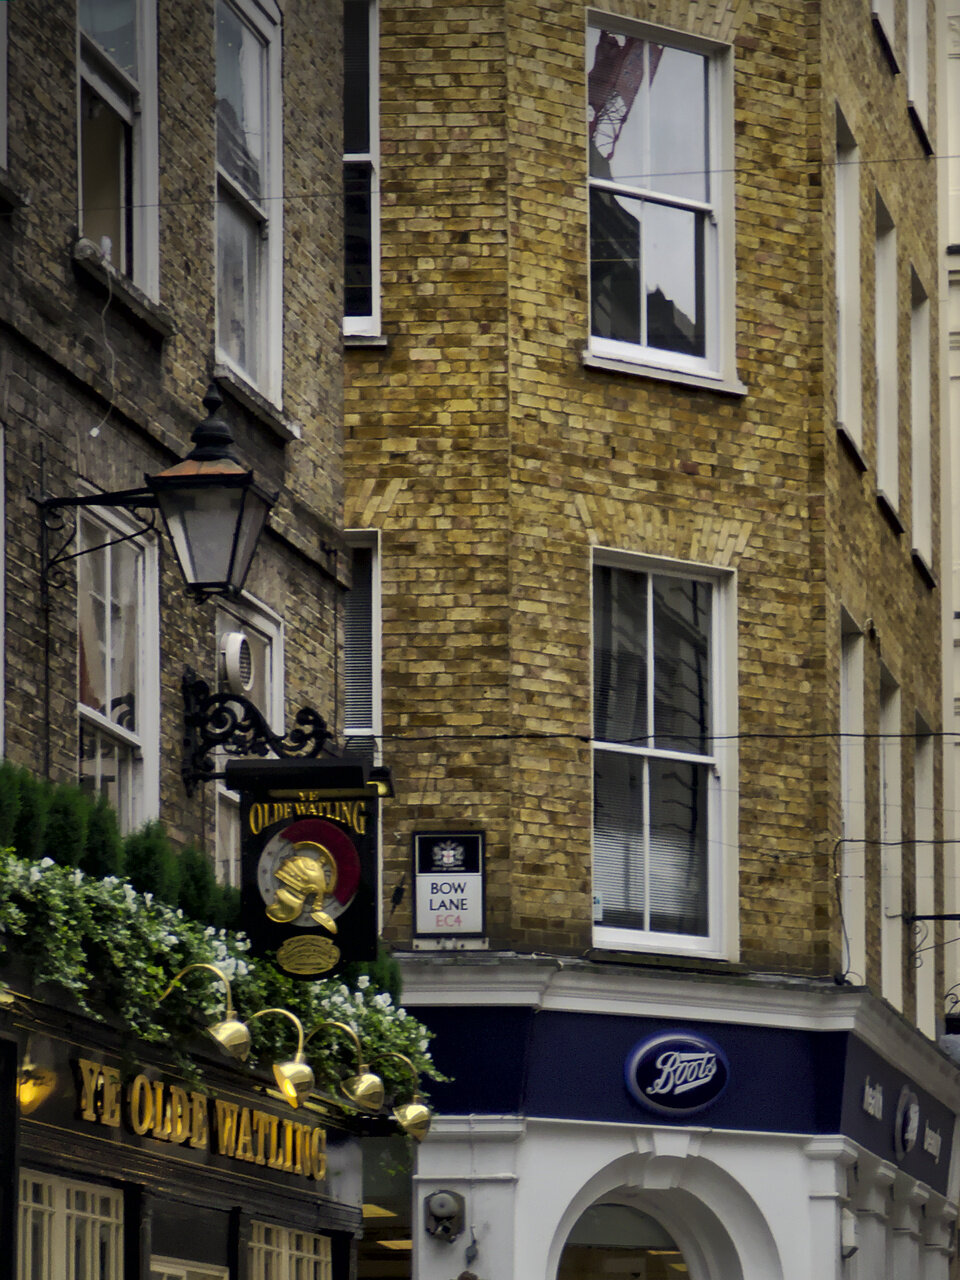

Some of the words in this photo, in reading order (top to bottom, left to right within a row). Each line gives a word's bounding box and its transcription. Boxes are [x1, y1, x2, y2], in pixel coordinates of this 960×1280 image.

[298, 791, 319, 800] YE
[250, 802, 292, 835] OLDE
[295, 801, 368, 835] WATLING
[431, 882, 467, 894] BOW
[429, 898, 468, 911] LANE
[435, 914, 462, 927] EC4
[646, 1051, 718, 1095] Boots
[78, 1058, 121, 1128] YE
[131, 1073, 208, 1150] OLDE
[215, 1099, 327, 1181] WATLING
